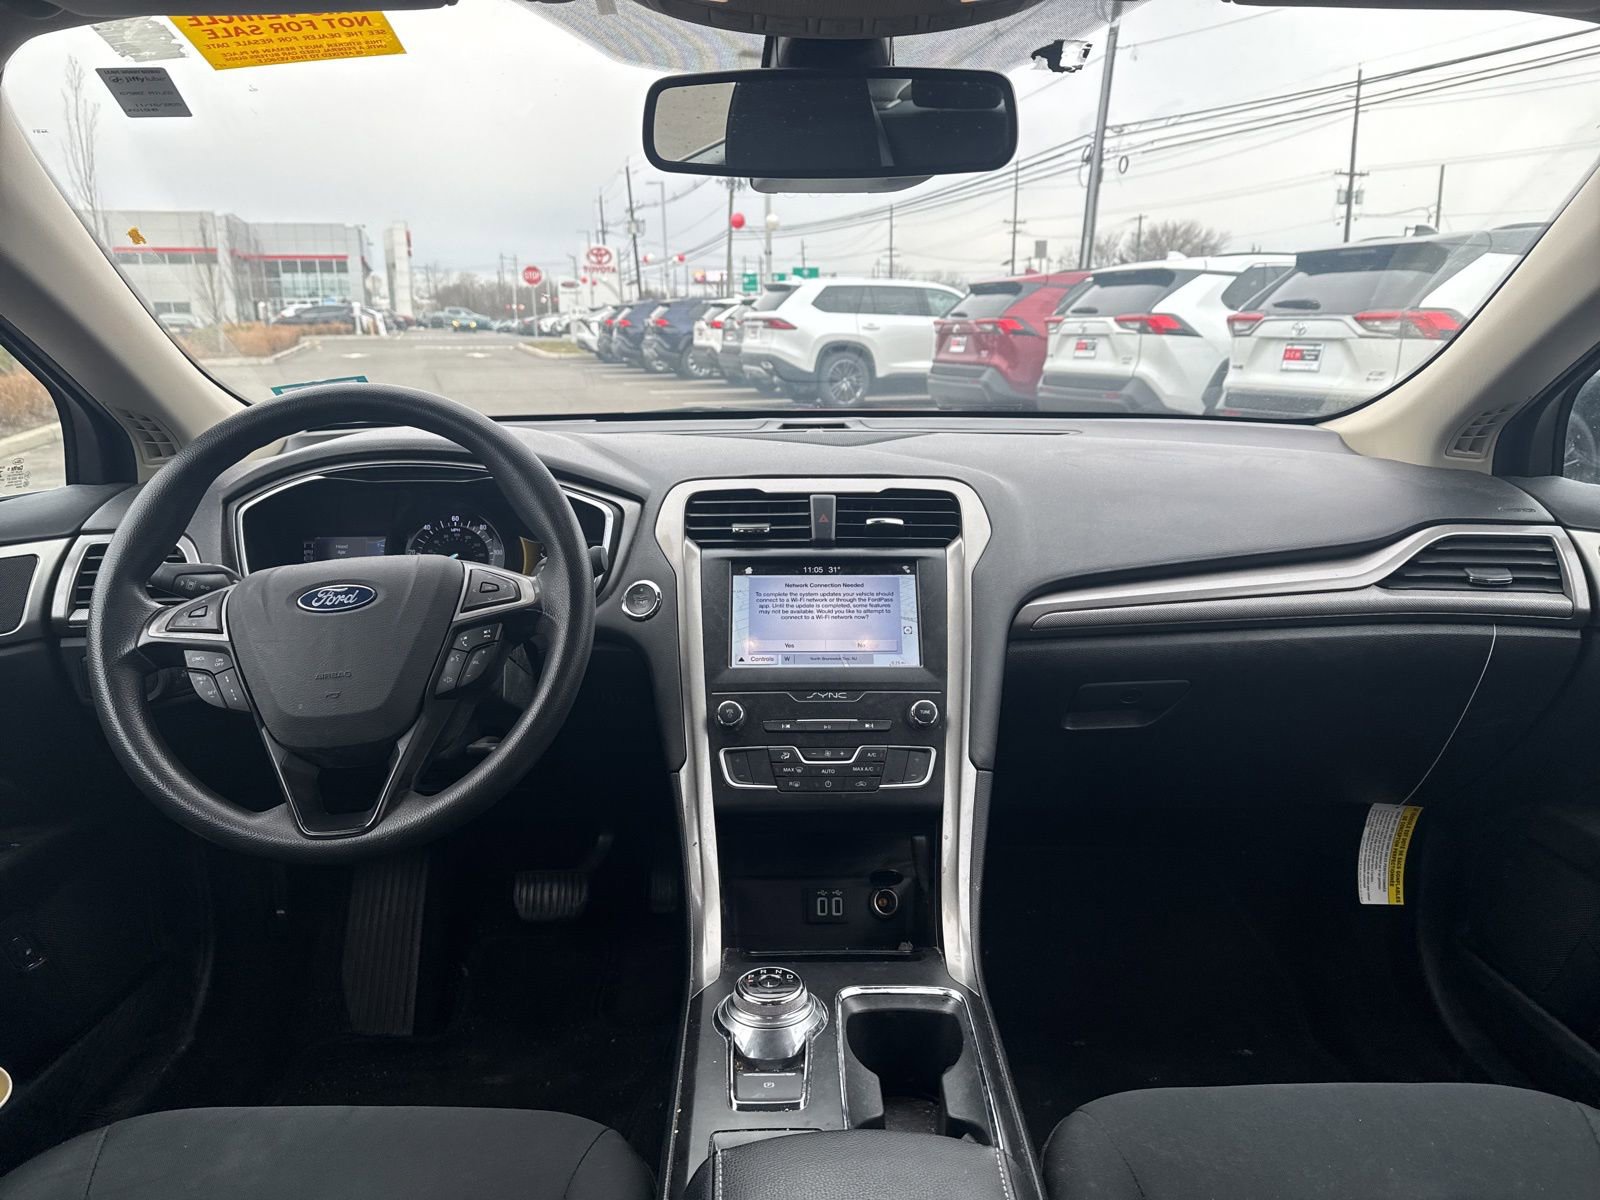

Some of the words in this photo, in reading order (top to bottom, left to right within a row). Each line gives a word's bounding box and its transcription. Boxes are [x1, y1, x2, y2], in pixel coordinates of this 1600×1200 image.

[524, 271, 541, 279] STOP
[311, 586, 359, 608] Ford
[314, 671, 353, 681] AIRBAG
